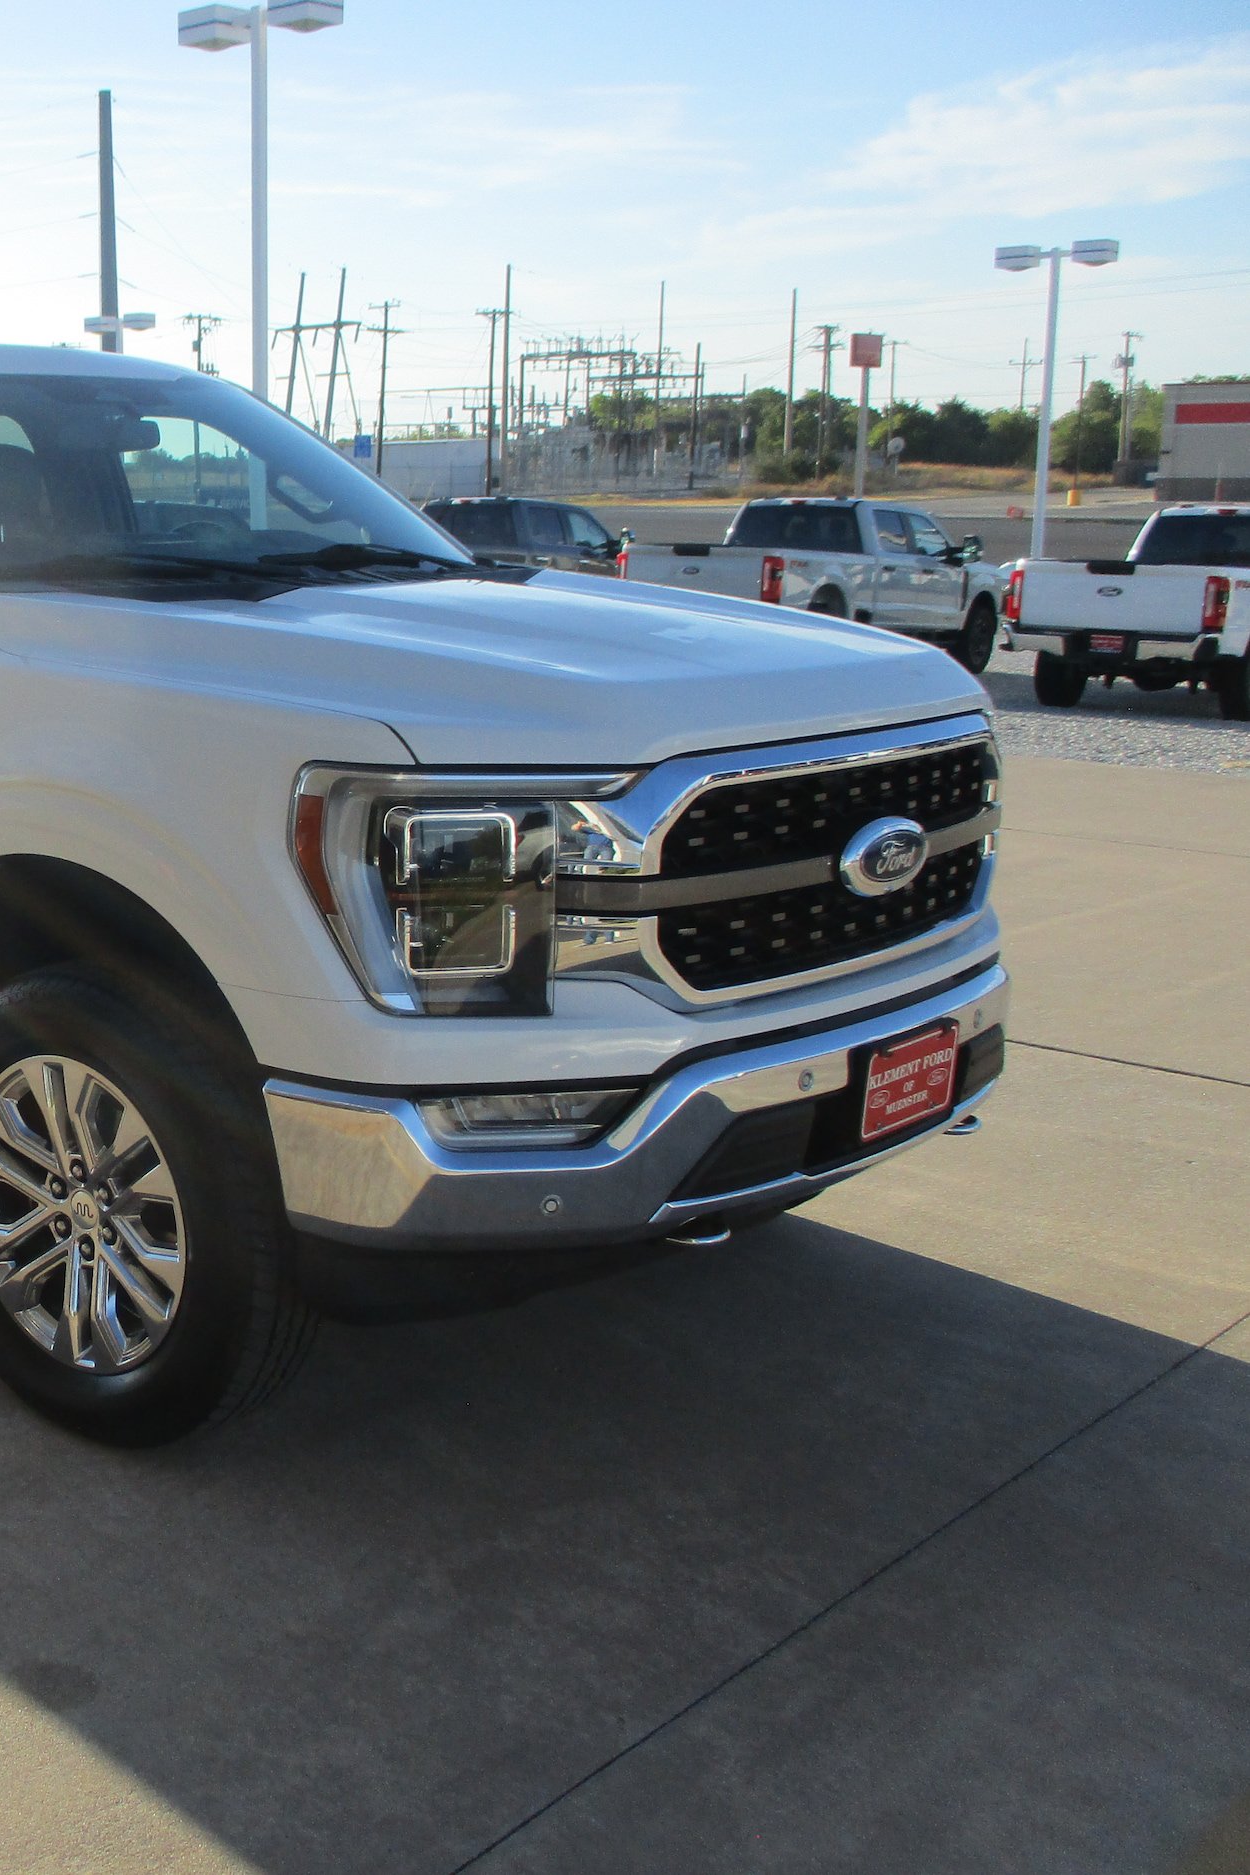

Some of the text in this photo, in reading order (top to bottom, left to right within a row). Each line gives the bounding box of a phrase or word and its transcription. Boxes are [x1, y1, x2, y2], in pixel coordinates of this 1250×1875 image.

[876, 839, 917, 875] Ford
[869, 1048, 953, 1090] KLEMENT FORD
[885, 1089, 928, 1115] MUENSTER
[903, 1080, 915, 1093] OF
